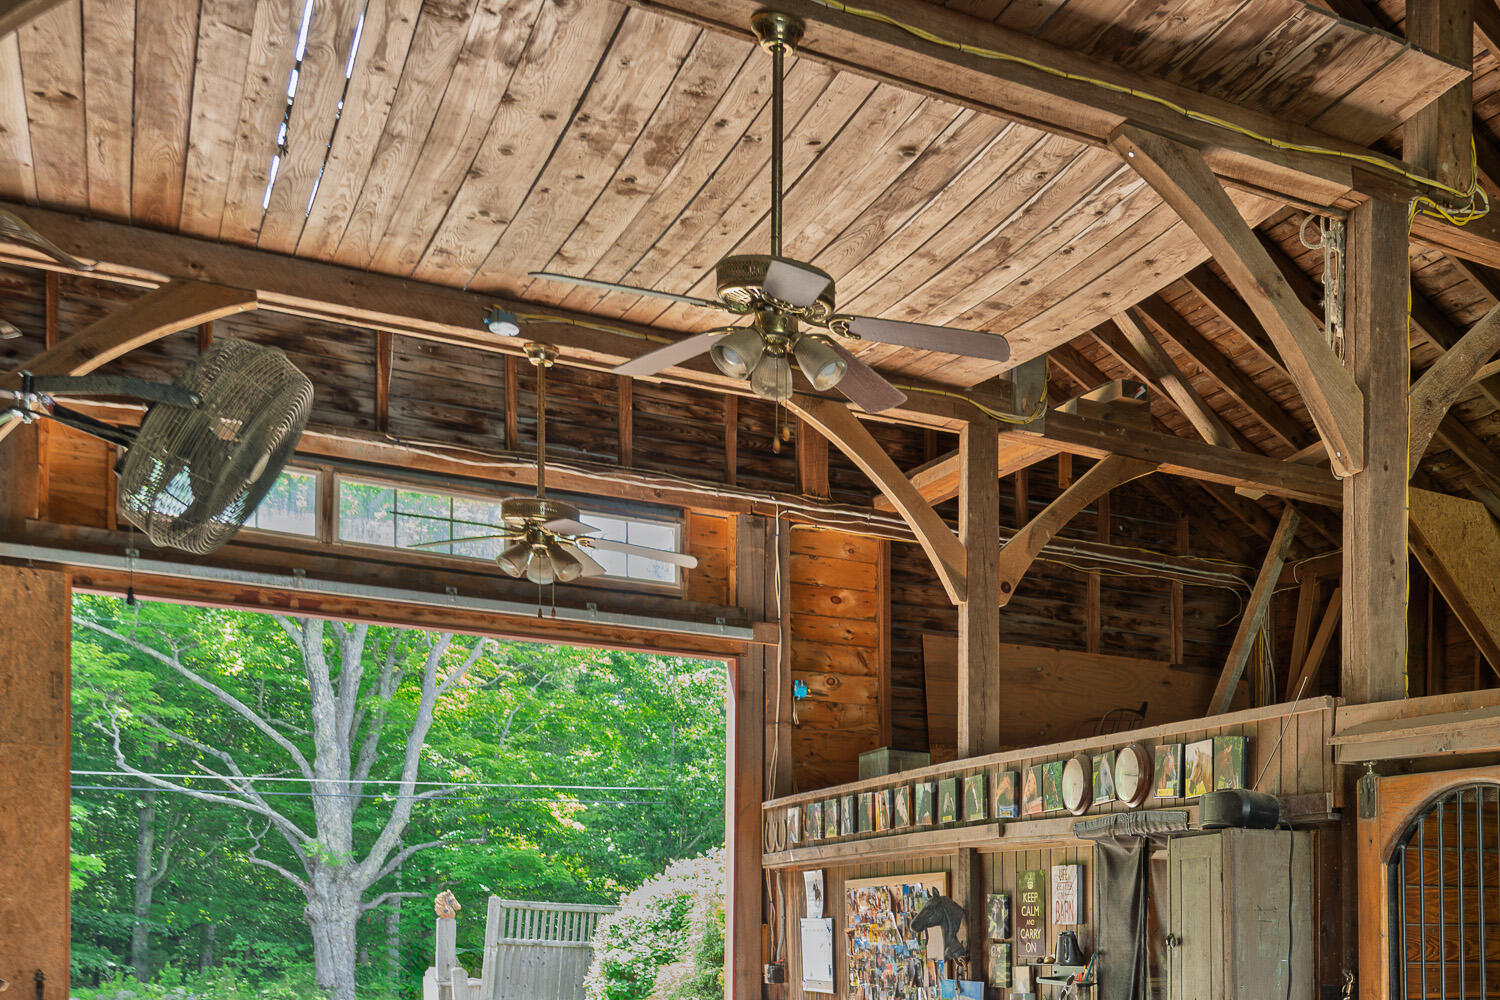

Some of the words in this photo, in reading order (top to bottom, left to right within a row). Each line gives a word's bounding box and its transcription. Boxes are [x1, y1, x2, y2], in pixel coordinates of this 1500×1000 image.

[1022, 892, 1038, 903] KEEP
[1021, 905, 1040, 917] CALM
[1020, 928, 1041, 940] CARRY
[1025, 942, 1037, 953] ON
